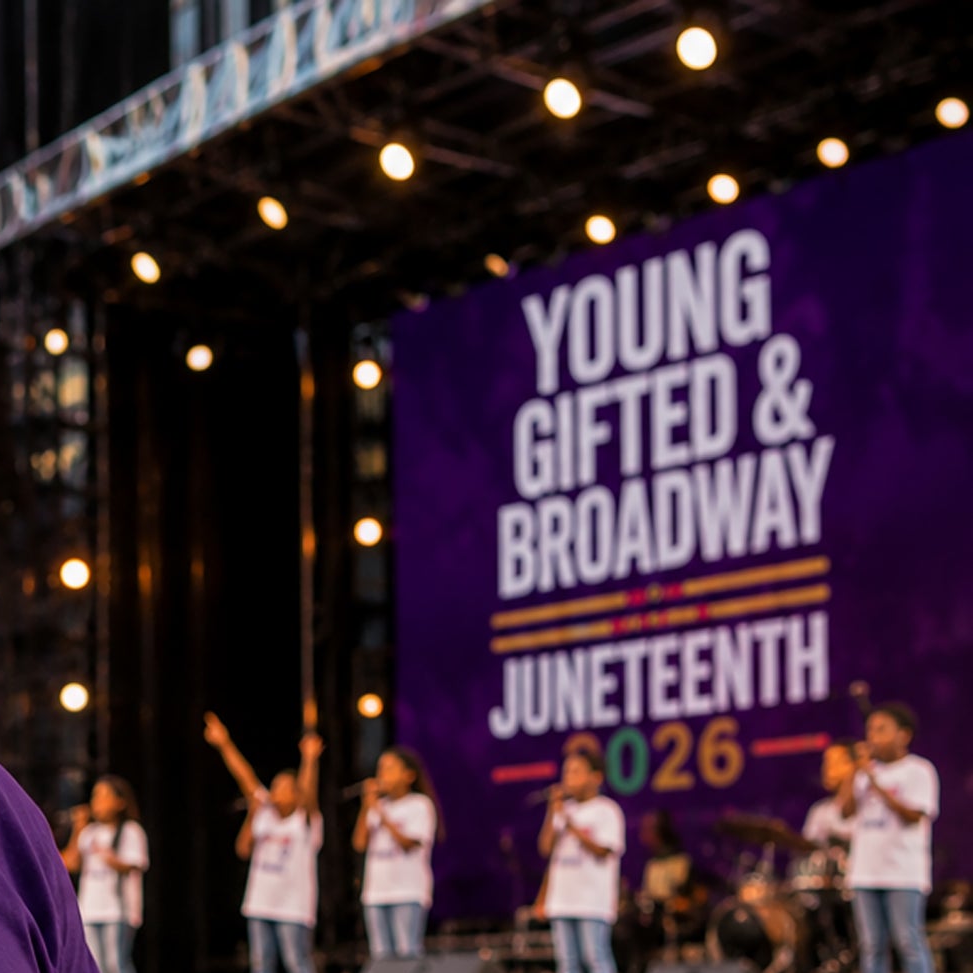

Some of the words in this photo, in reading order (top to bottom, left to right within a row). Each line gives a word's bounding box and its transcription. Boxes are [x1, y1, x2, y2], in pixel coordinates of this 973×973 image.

[522, 230, 772, 394] YOUNG
[513, 352, 739, 499] GIFTED
[753, 333, 816, 446] &
[497, 437, 835, 598] BROADWAY
[489, 612, 829, 738] JUNETEENTH
